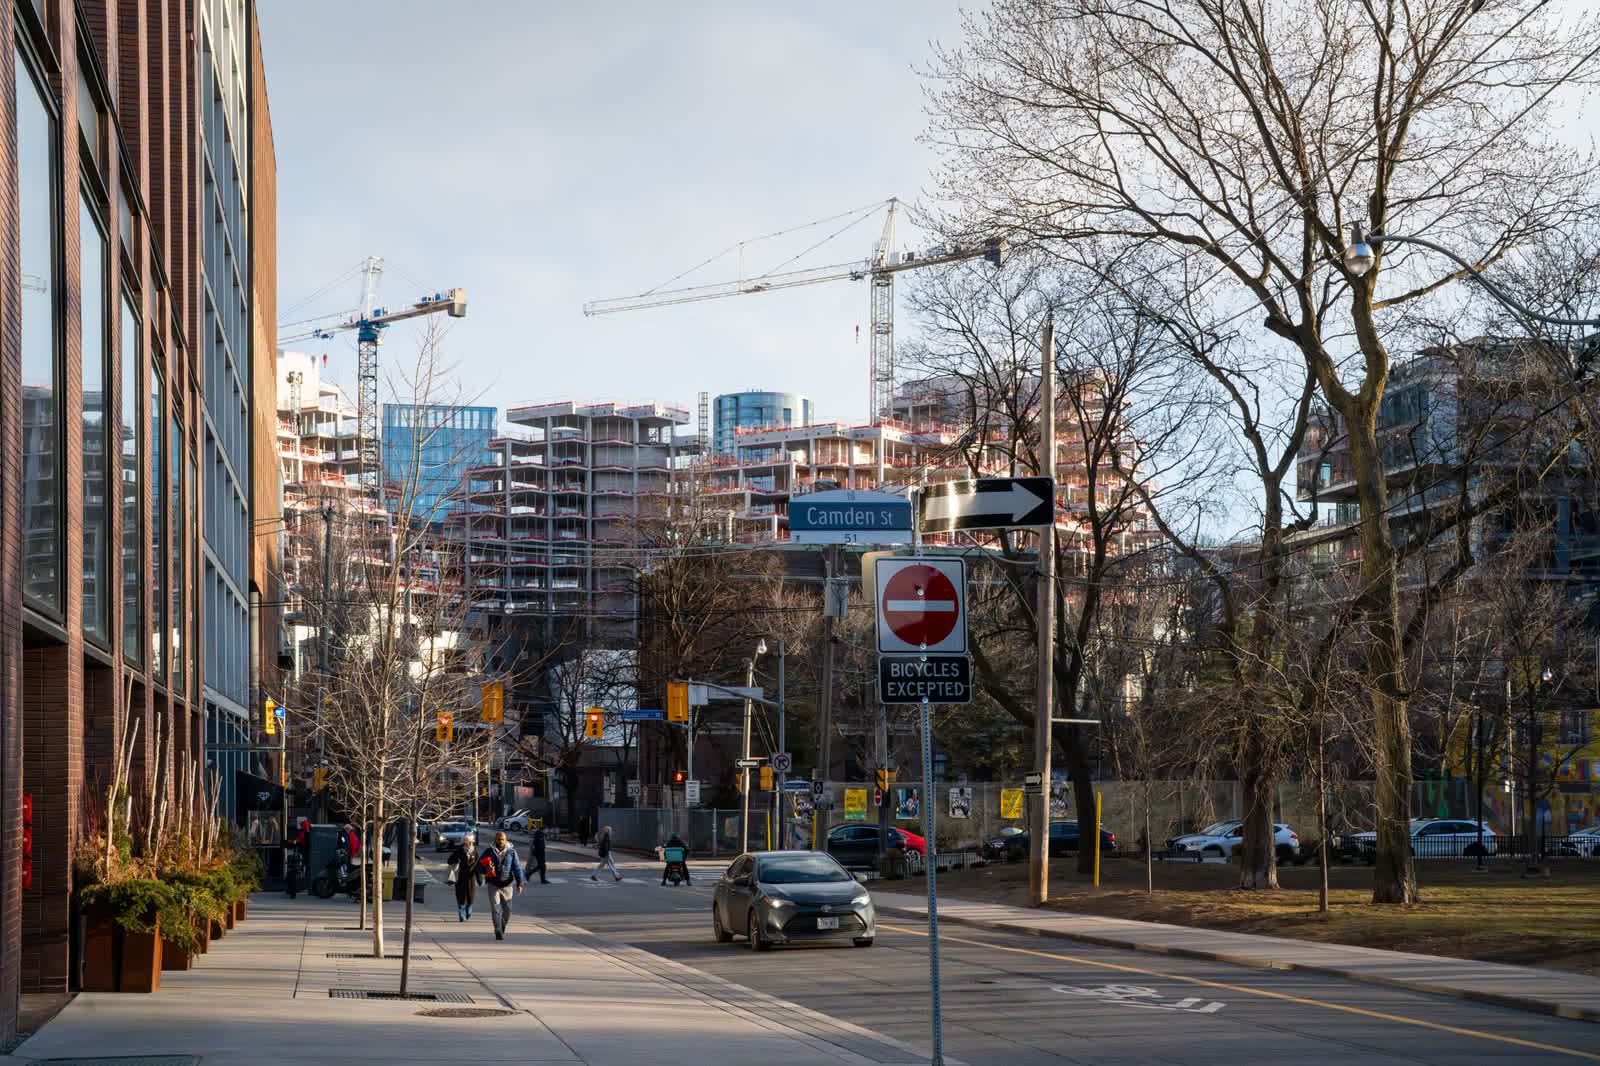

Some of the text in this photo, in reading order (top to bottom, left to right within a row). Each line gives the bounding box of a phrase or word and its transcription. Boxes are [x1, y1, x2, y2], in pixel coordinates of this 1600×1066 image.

[807, 507, 893, 525] Camden St
[844, 533, 857, 543] 51
[890, 663, 960, 677] BICYCLES
[887, 682, 964, 697] EXCEPTED
